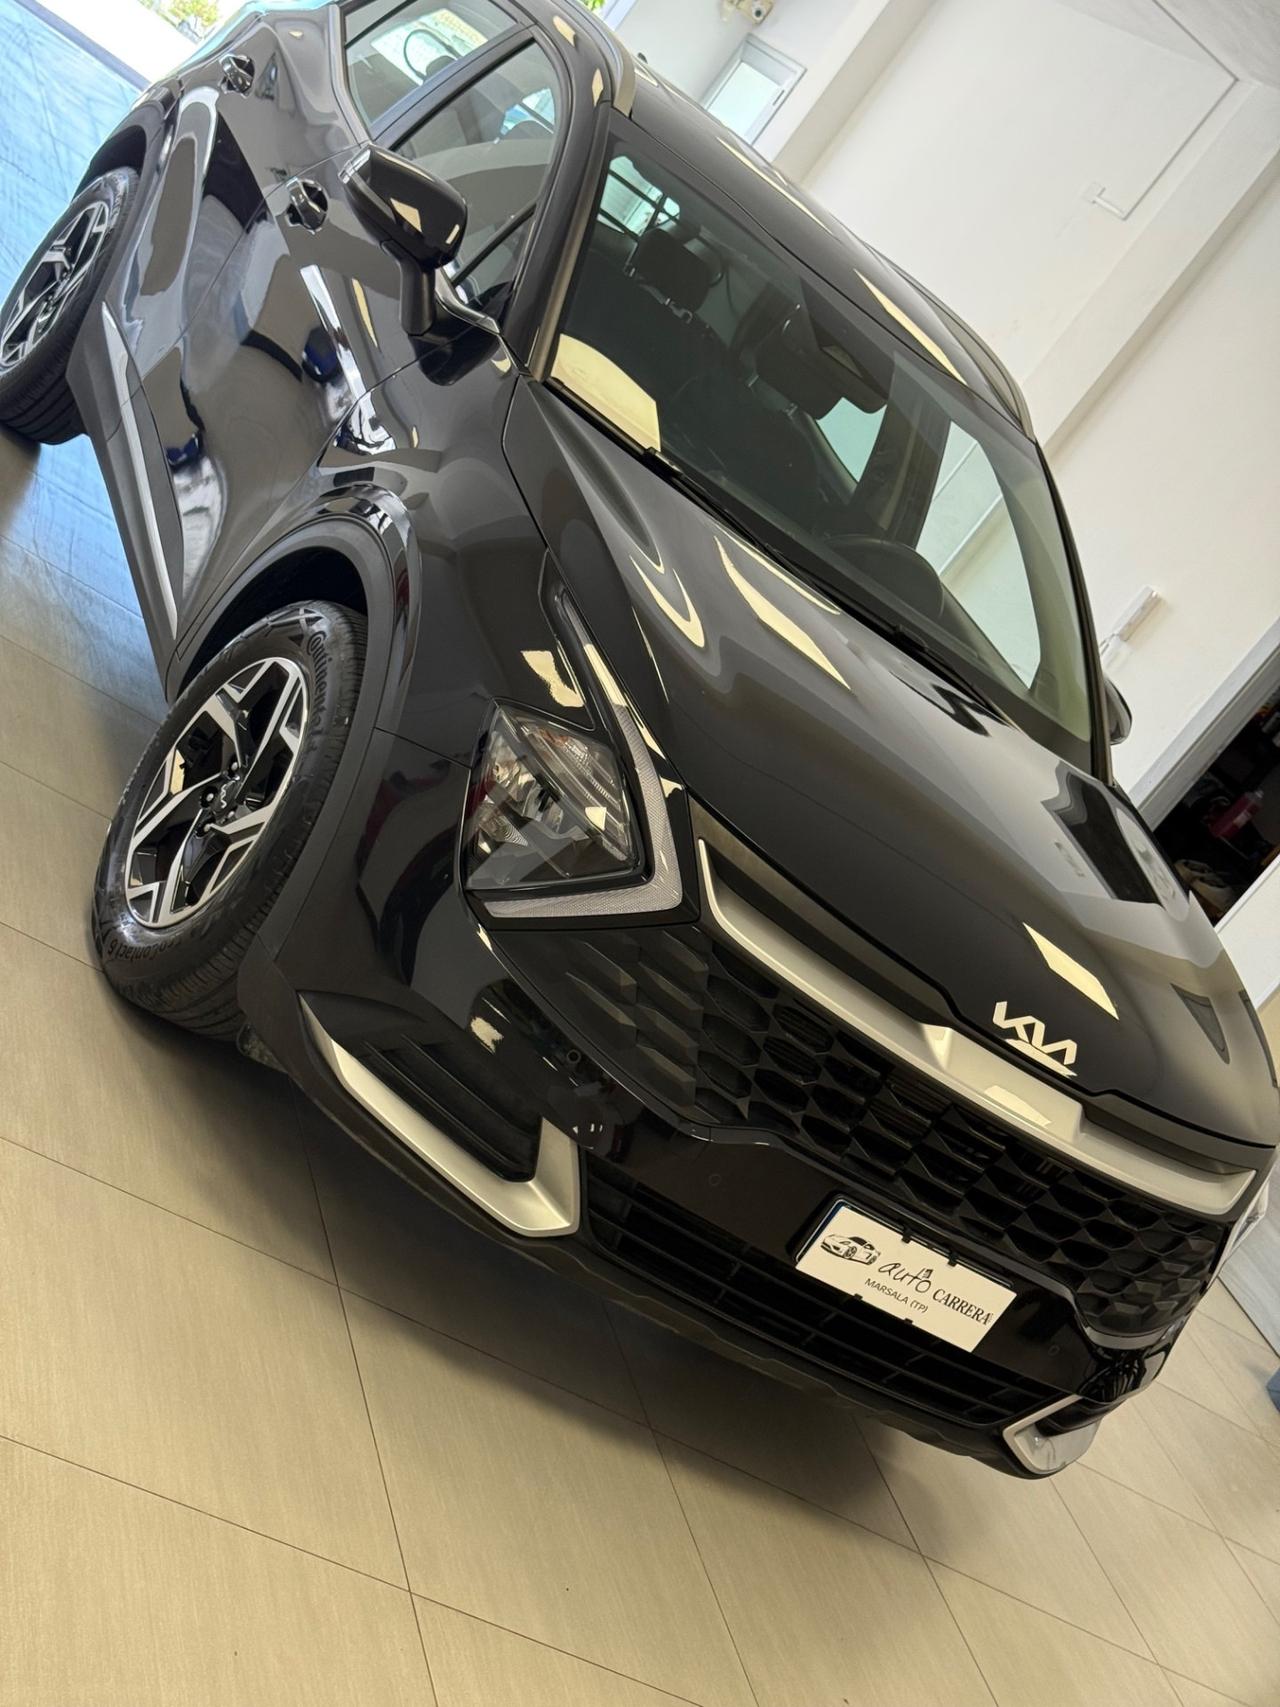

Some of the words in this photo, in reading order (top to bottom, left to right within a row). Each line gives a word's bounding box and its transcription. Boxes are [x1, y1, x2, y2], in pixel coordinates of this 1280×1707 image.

[865, 1277, 909, 1305] MARSALA
[910, 1299, 929, 1314] (TP)
[932, 1288, 991, 1326] CARRERA
